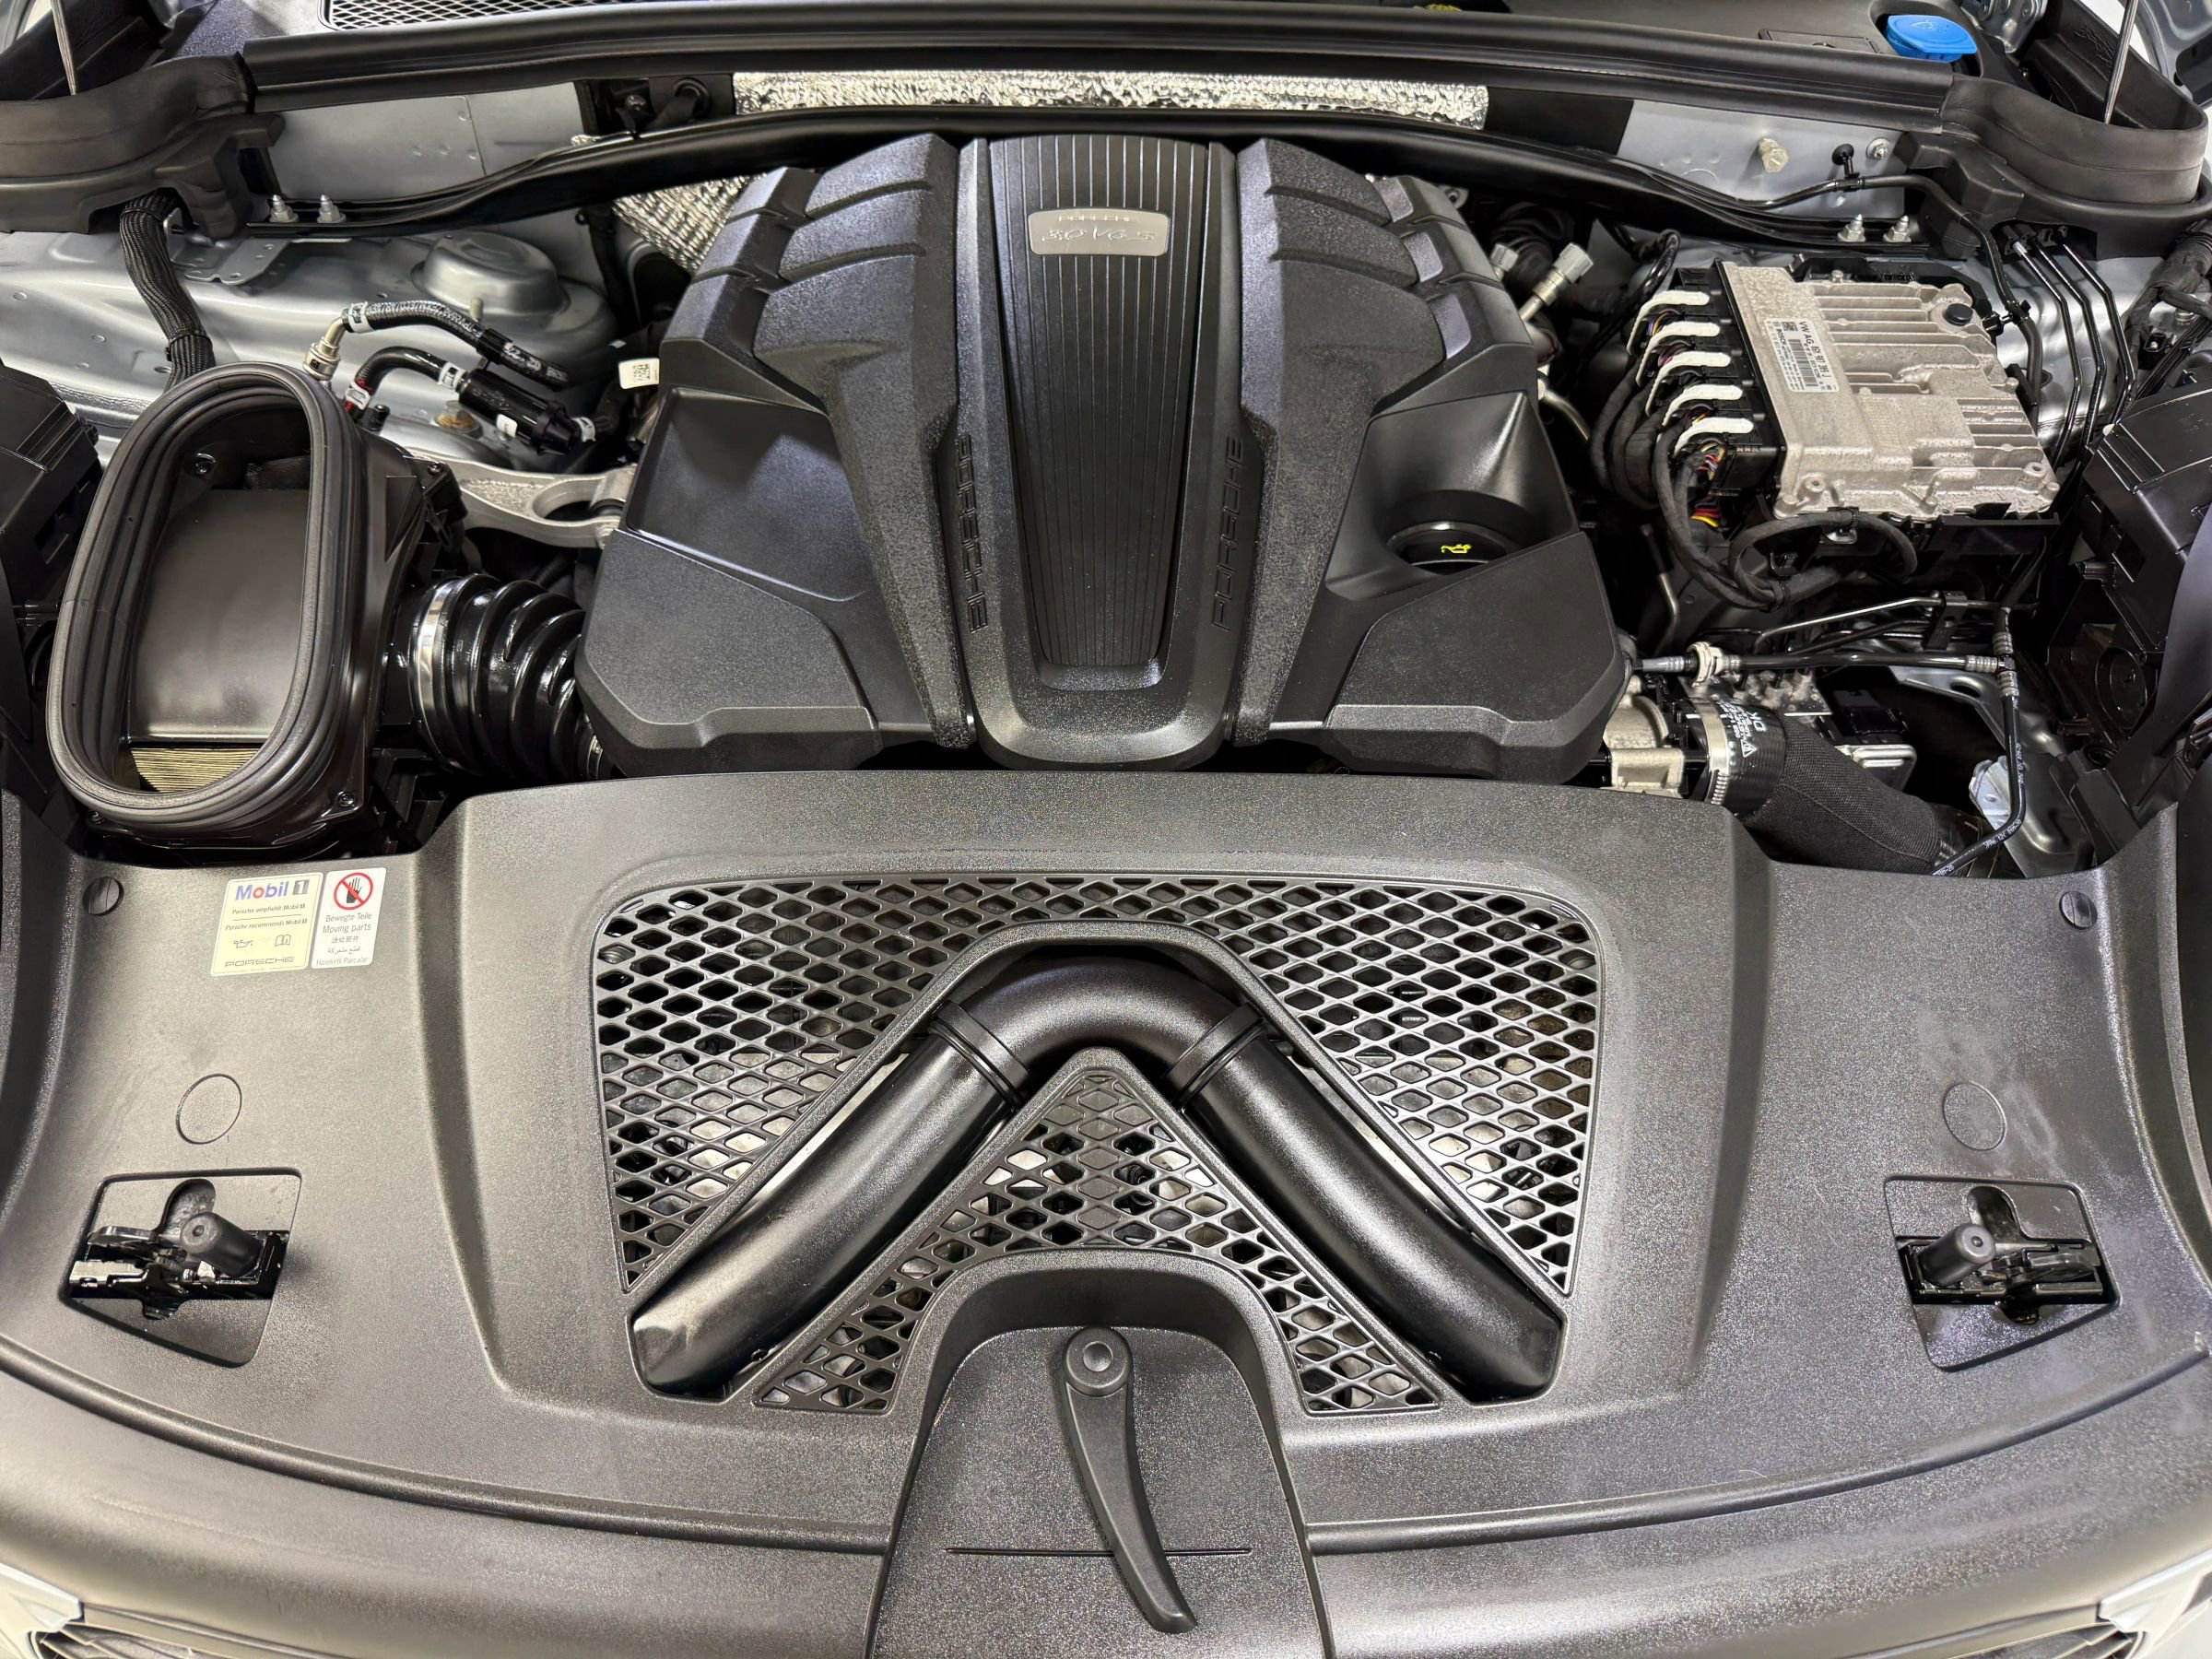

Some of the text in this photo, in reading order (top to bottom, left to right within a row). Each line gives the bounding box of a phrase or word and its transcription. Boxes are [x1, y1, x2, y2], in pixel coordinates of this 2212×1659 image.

[954, 433, 988, 633] PORSCHE
[1212, 434, 1244, 632] PORSCHE
[235, 879, 310, 900] Mobil 1
[325, 914, 355, 923] Bewegte
[323, 924, 371, 934] Moving parts
[225, 956, 296, 968] PORSCHE
